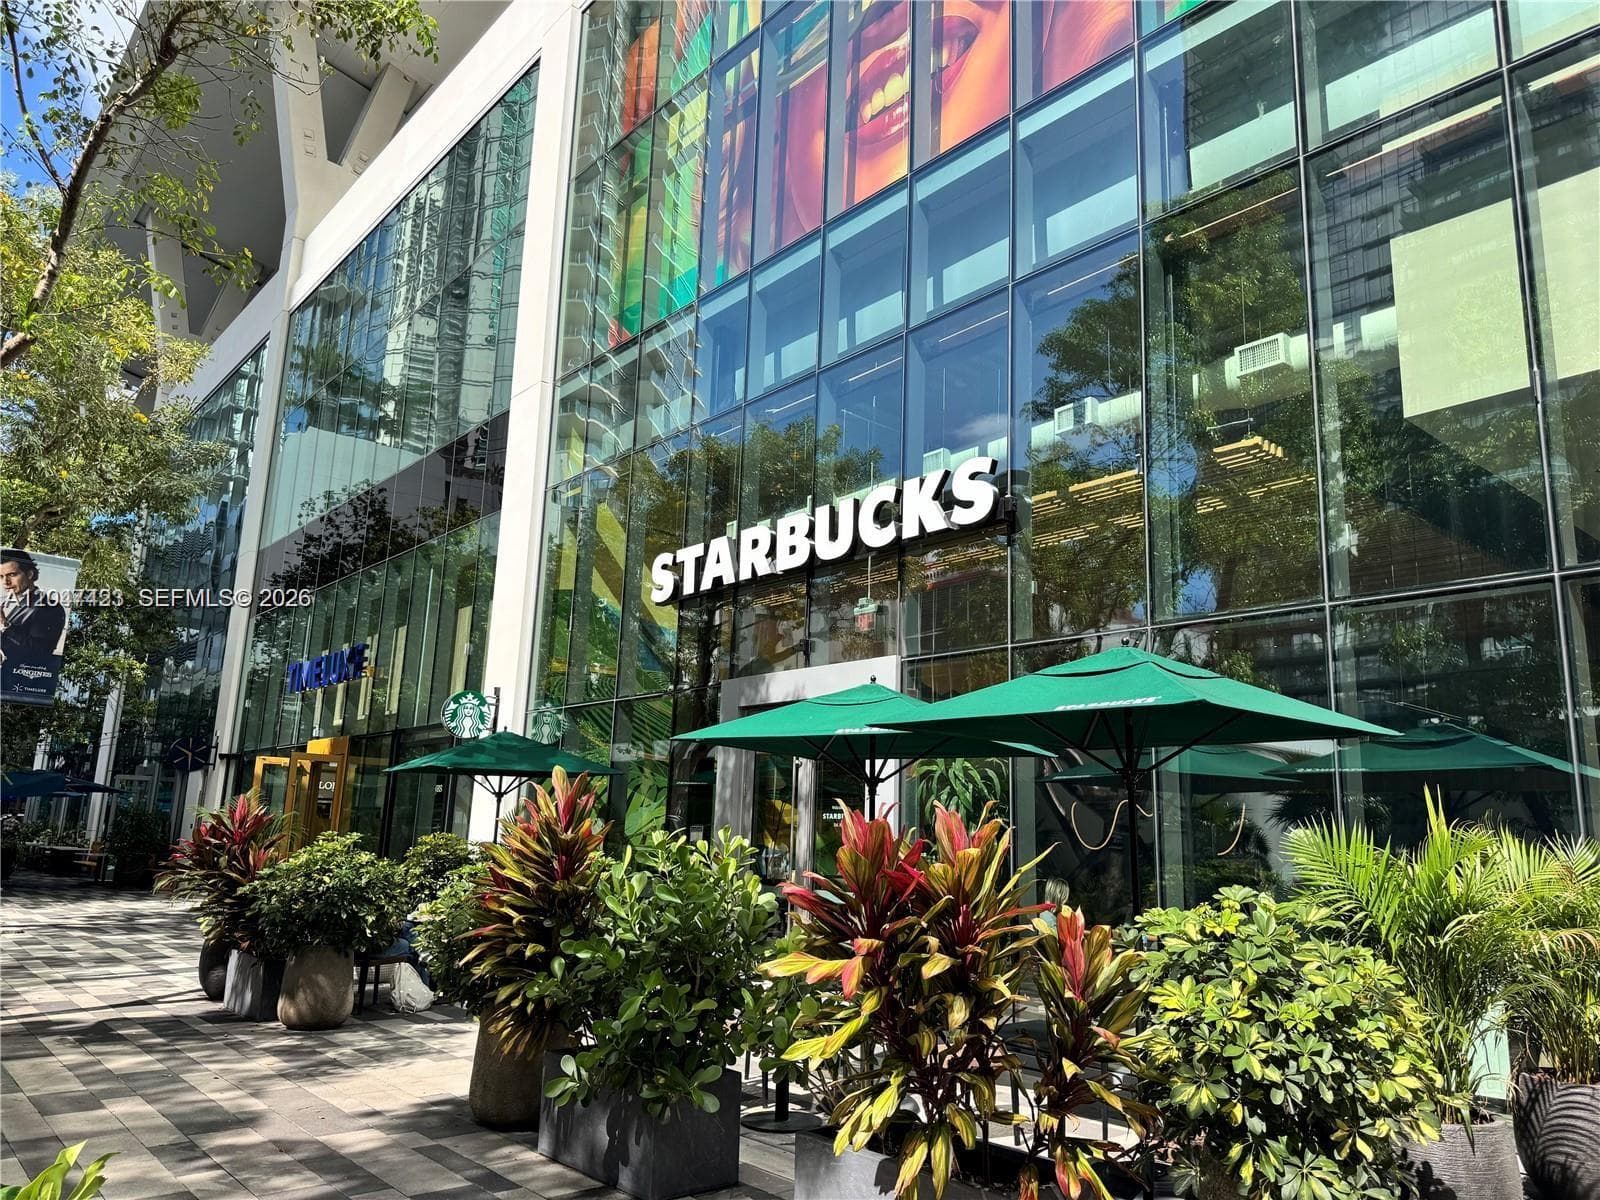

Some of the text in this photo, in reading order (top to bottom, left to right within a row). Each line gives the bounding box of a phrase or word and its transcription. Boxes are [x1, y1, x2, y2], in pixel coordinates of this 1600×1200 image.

[650, 456, 997, 604] STARBUCKS
[13, 668, 52, 679] LONGINES
[822, 812, 844, 821] STARB
